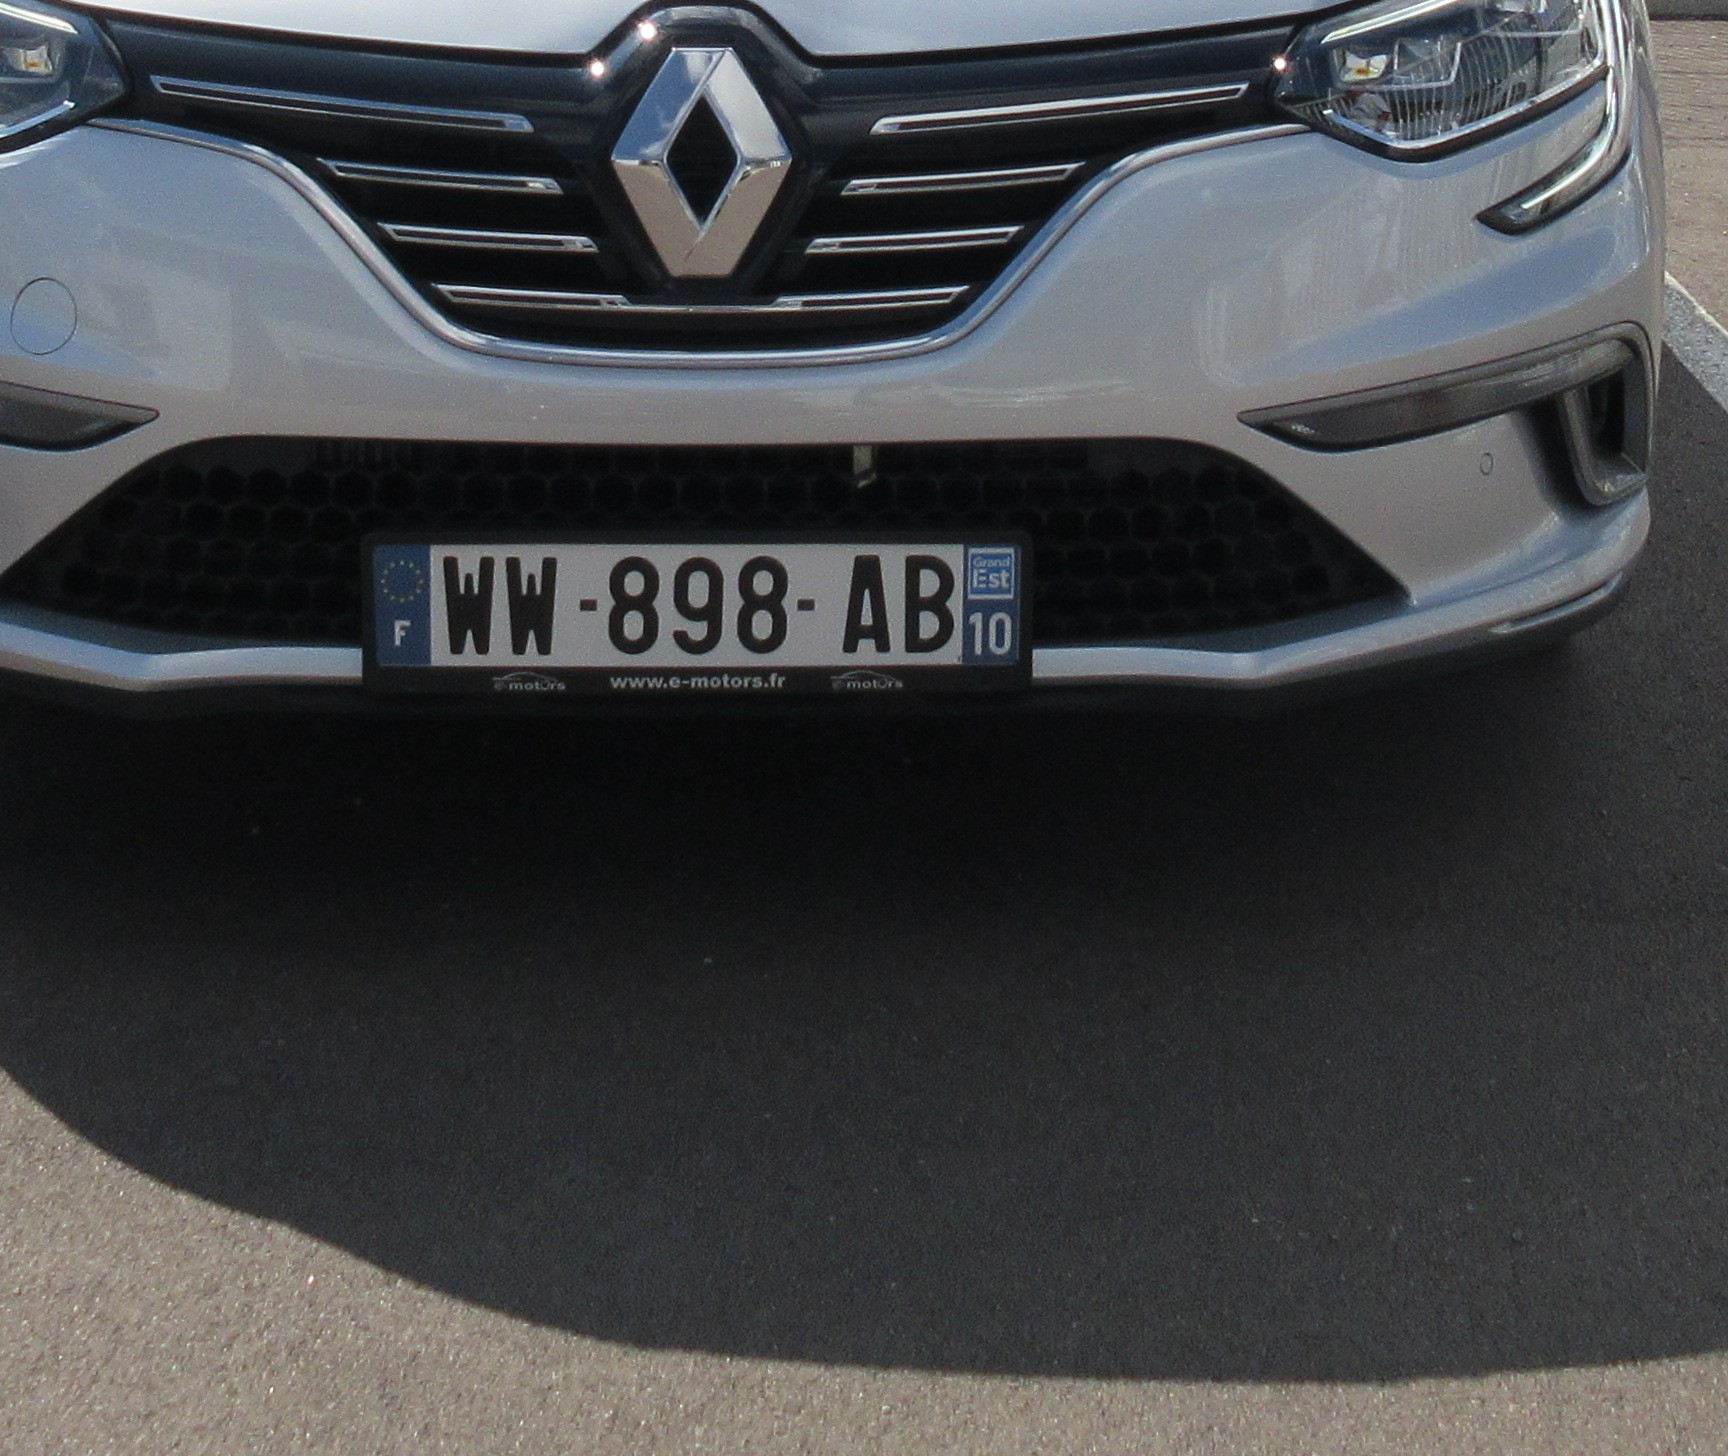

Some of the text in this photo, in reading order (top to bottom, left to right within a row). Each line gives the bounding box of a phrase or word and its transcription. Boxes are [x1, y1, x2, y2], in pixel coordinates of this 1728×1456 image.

[973, 556, 1011, 568] Grand
[973, 568, 1010, 588] Est
[394, 619, 411, 646] F
[969, 611, 1012, 655] 10
[610, 673, 786, 689] www.e-motors.fr
